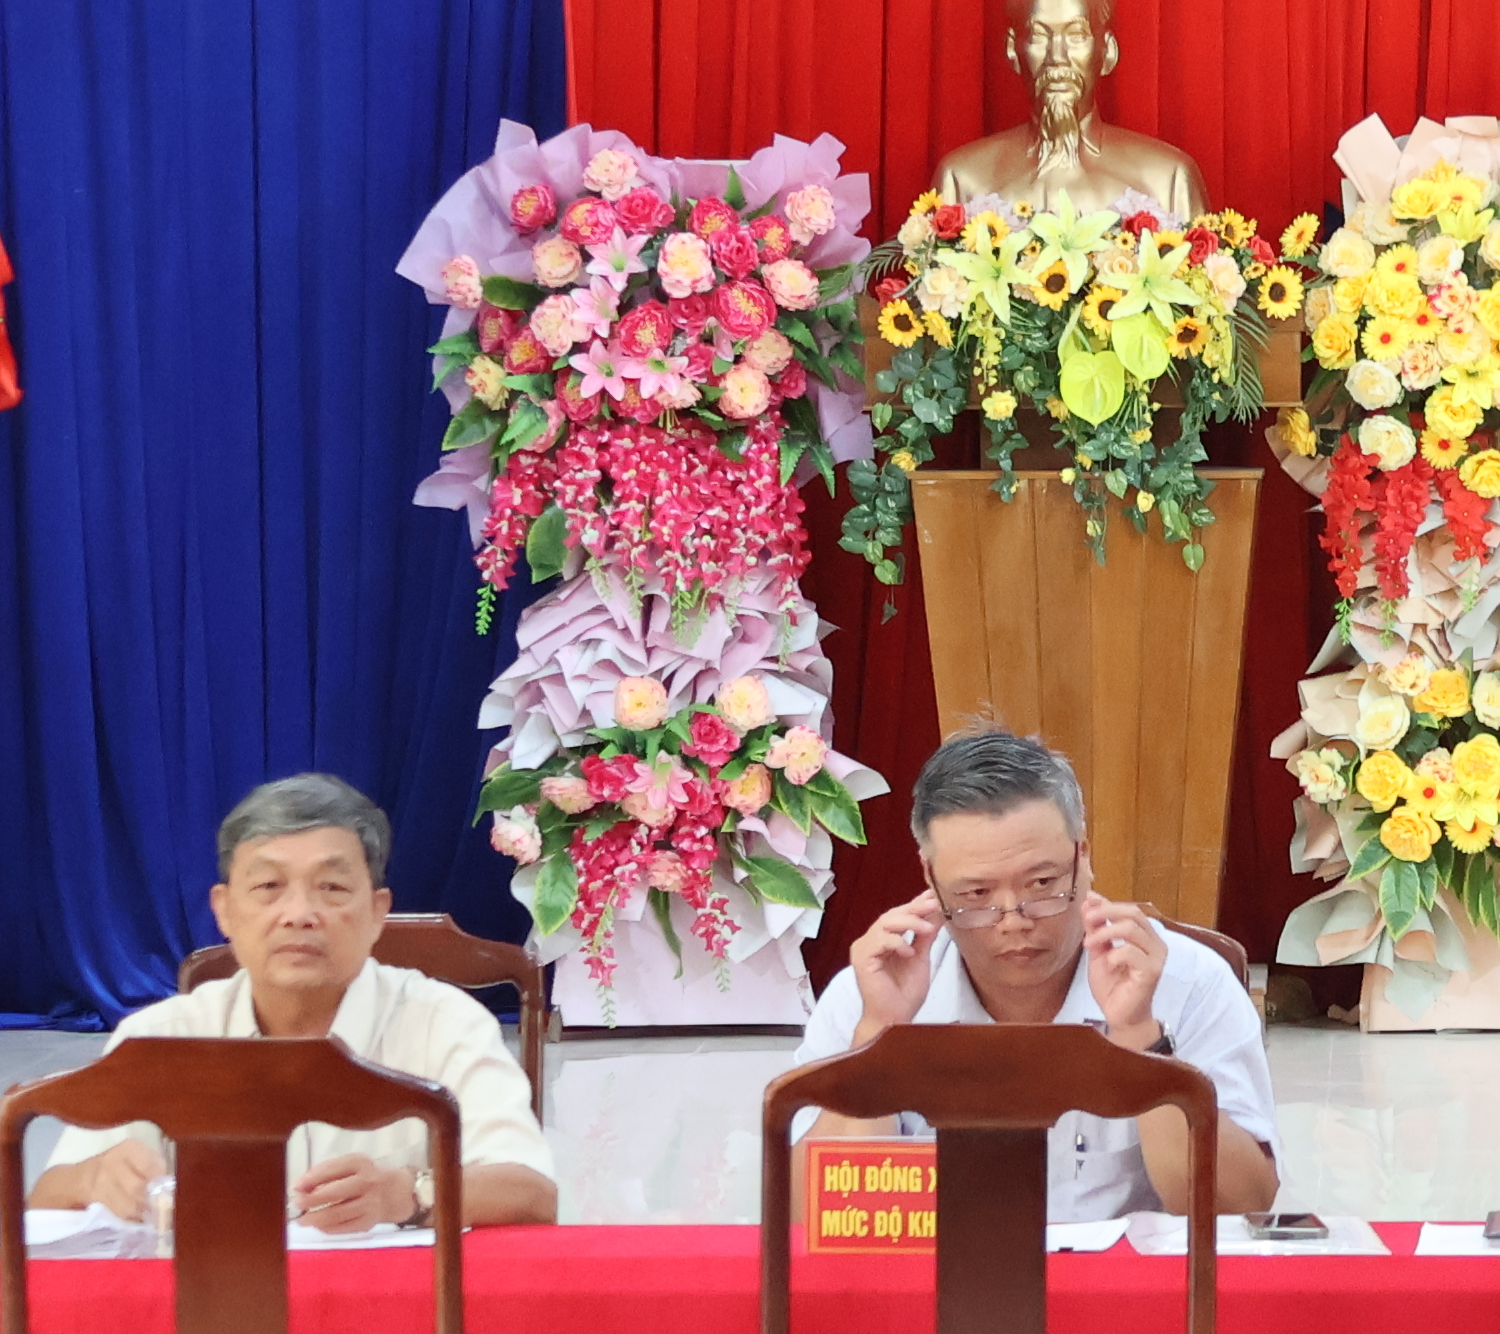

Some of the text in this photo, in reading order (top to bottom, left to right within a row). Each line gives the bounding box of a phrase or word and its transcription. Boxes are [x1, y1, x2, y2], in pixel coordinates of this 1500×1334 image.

[824, 1159, 859, 1198] HỘI
[821, 1204, 869, 1237] MỨC
[874, 1205, 903, 1243] ĐỘ
